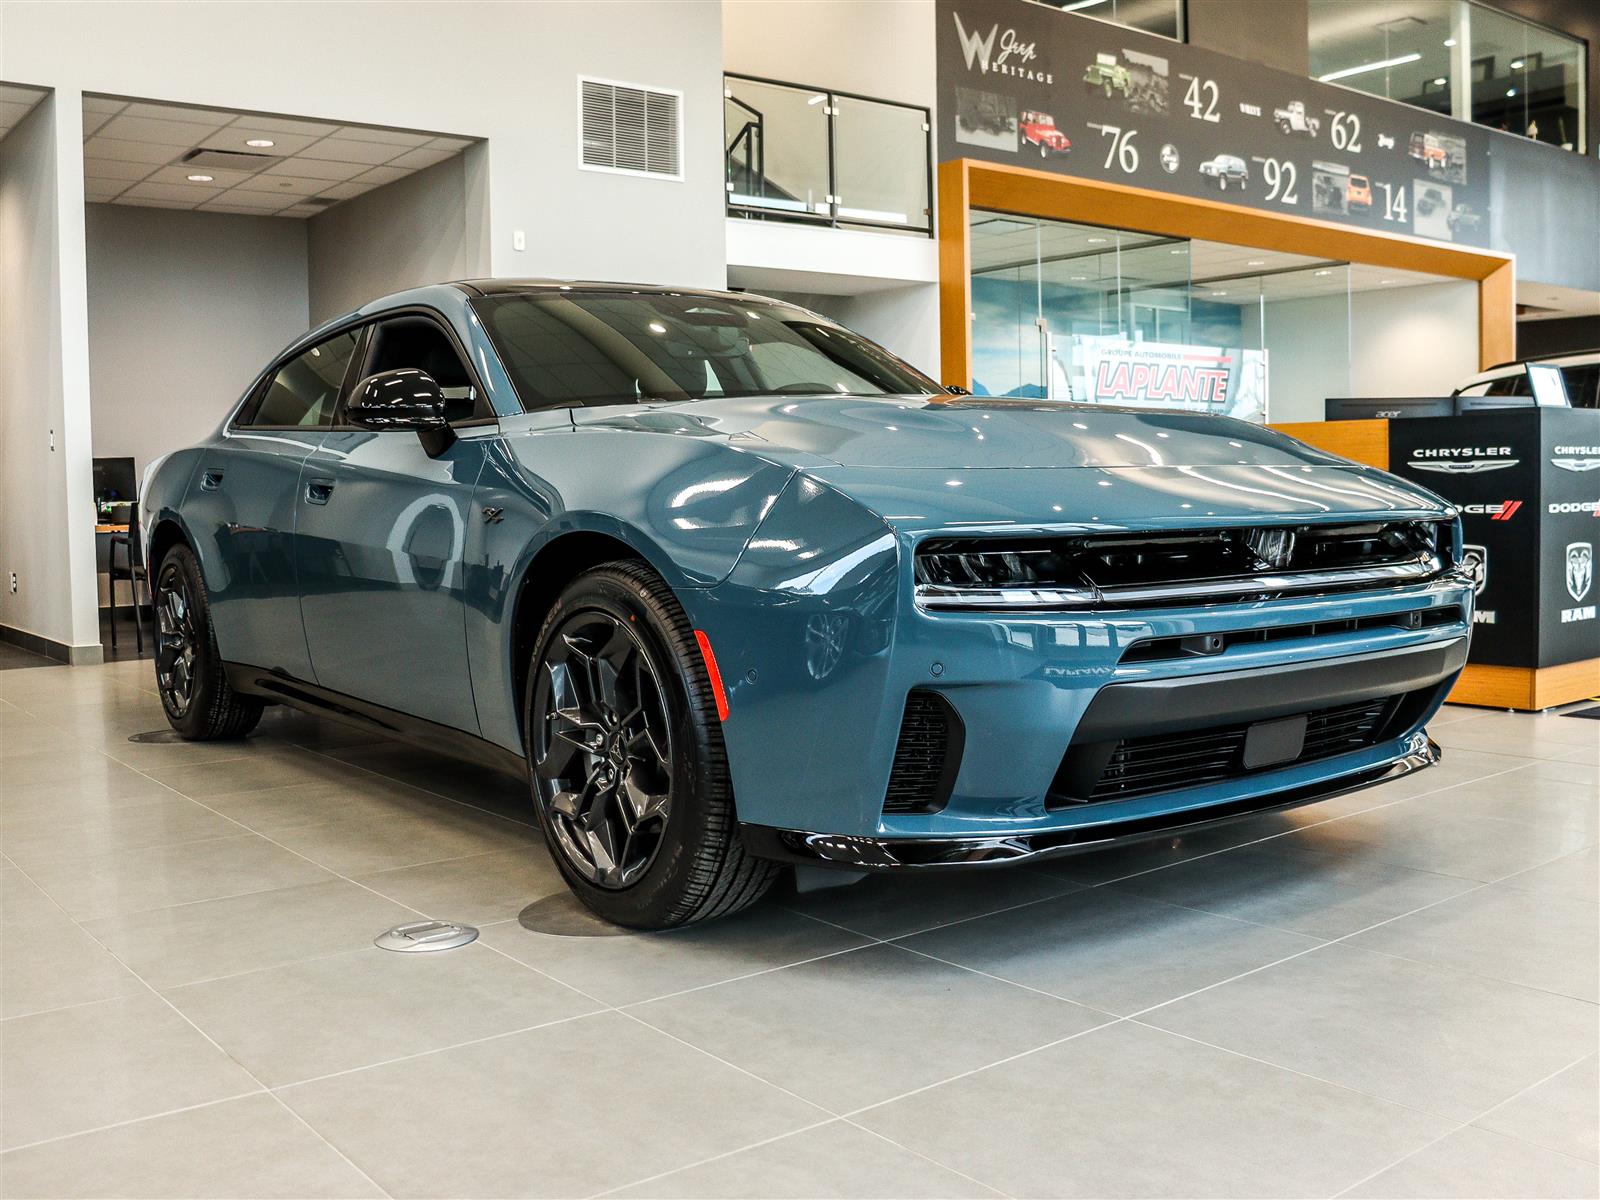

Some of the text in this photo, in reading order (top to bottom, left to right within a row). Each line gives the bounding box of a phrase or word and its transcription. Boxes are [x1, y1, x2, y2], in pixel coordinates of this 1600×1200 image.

[997, 28, 1036, 63] Jeep
[981, 60, 1053, 84] HERITAGE
[1184, 76, 1221, 123] 42
[1101, 125, 1139, 174] 76
[1330, 111, 1362, 153] 62
[1263, 157, 1298, 204] 92
[1381, 183, 1408, 223] 14
[1096, 360, 1230, 403] LAPLANTE
[1413, 446, 1511, 458] CHRYSLER
[1554, 445, 1600, 455] CHRYSLE
[1561, 605, 1596, 623] RAM
